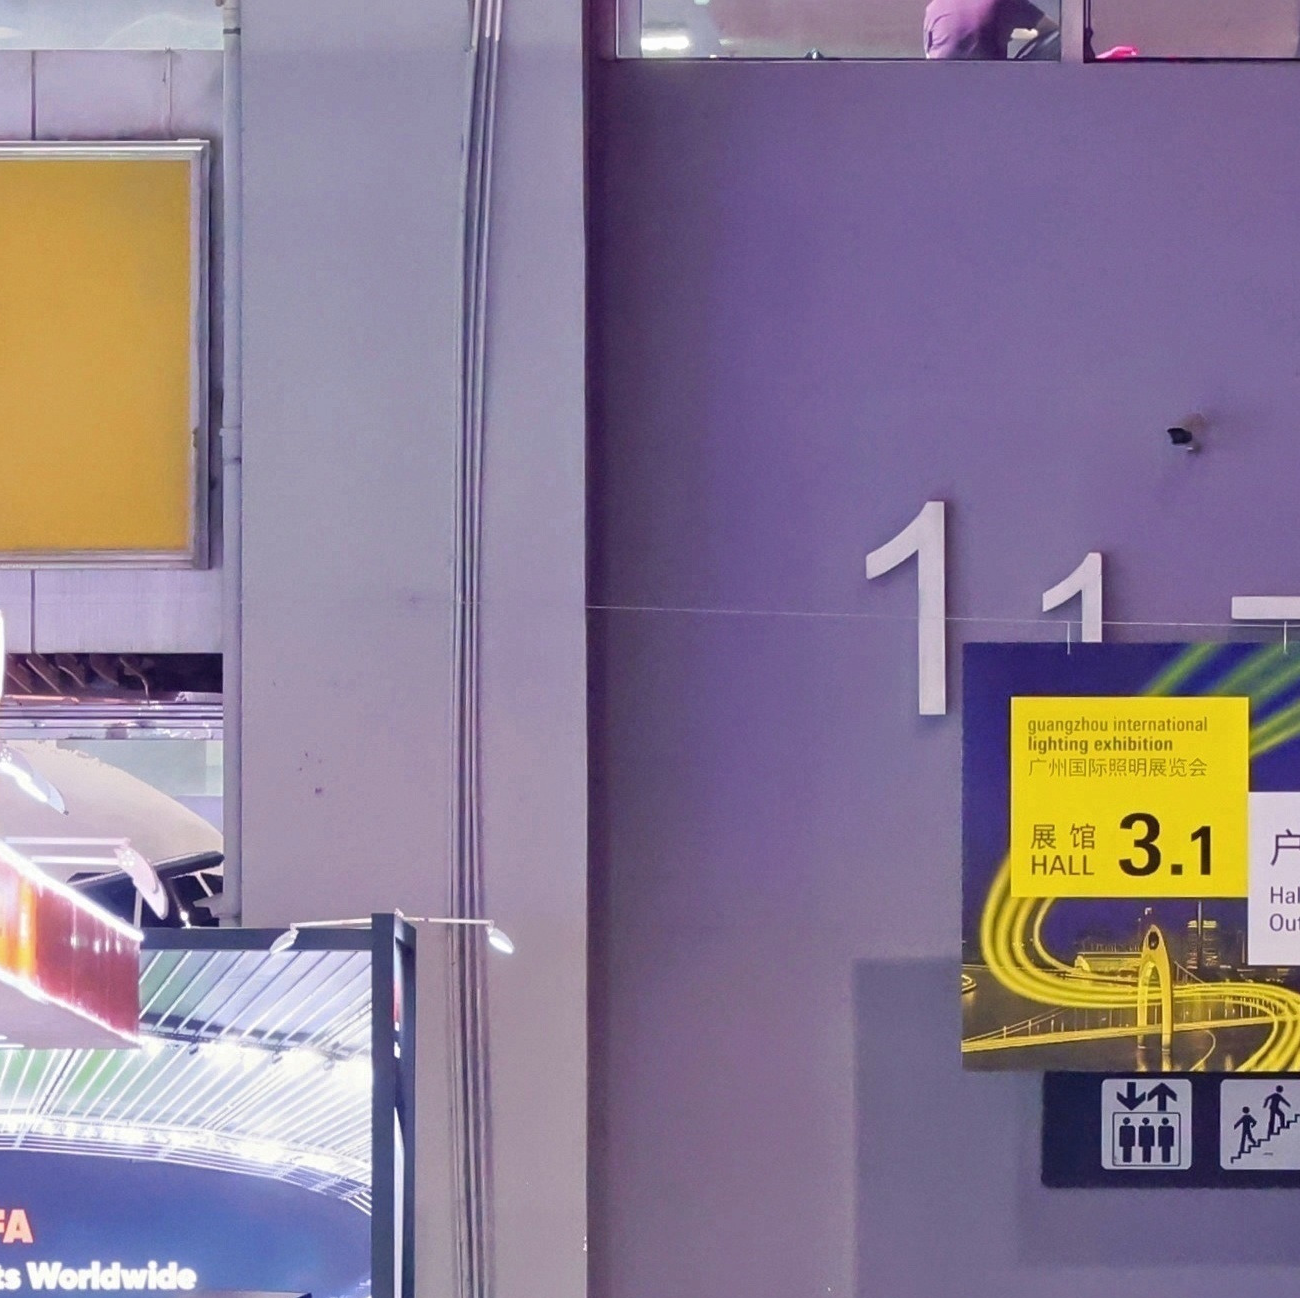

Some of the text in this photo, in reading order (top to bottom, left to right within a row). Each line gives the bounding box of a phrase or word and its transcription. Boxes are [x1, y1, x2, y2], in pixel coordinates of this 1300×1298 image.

[1028, 717, 1208, 735] guangzhou international
[1028, 737, 1173, 755] lighting exhibition
[1028, 758, 1208, 777] 广州国际照明展览会
[1031, 812, 1211, 877] HALL 3.1
[26, 1260, 198, 1291] Worldwide
